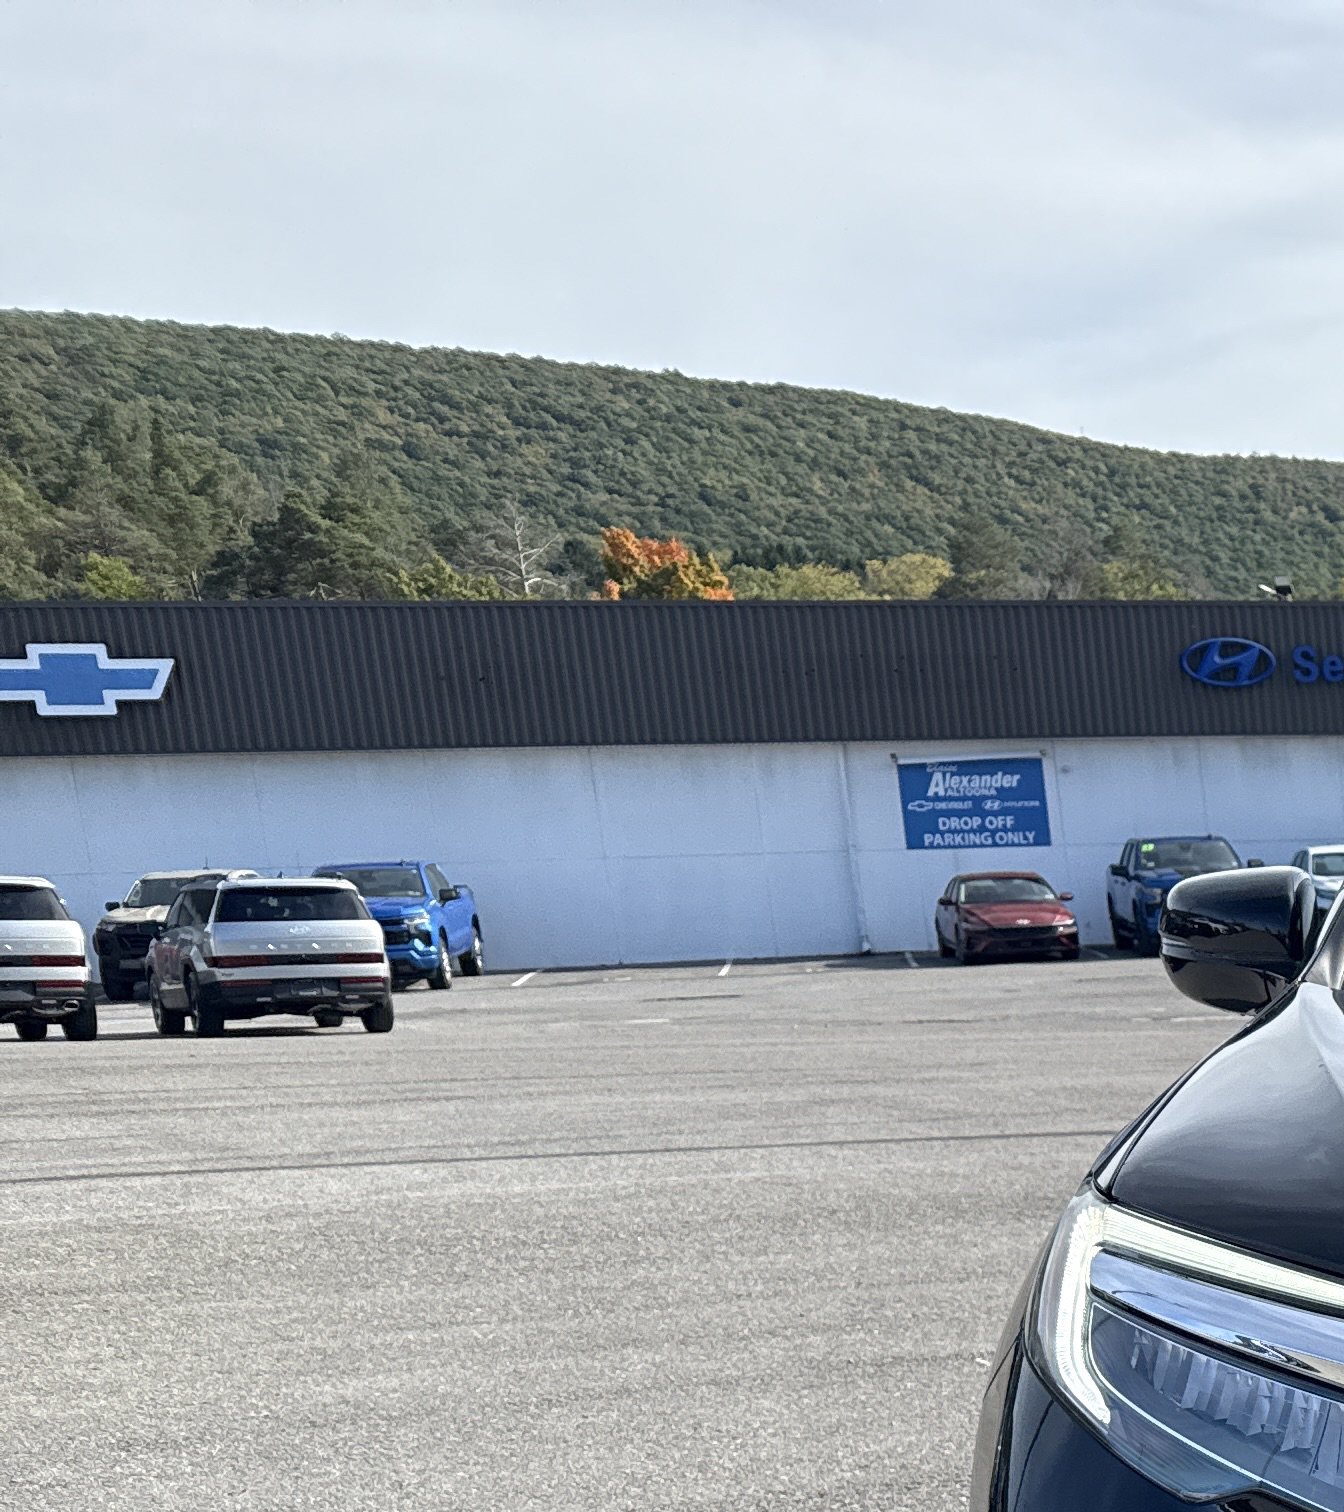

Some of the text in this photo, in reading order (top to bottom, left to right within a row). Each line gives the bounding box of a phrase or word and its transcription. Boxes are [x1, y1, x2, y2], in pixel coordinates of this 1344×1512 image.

[926, 771, 1021, 797] Alexander
[938, 815, 1015, 831] DROP OFF
[923, 831, 1036, 847] PARKING ONLY
